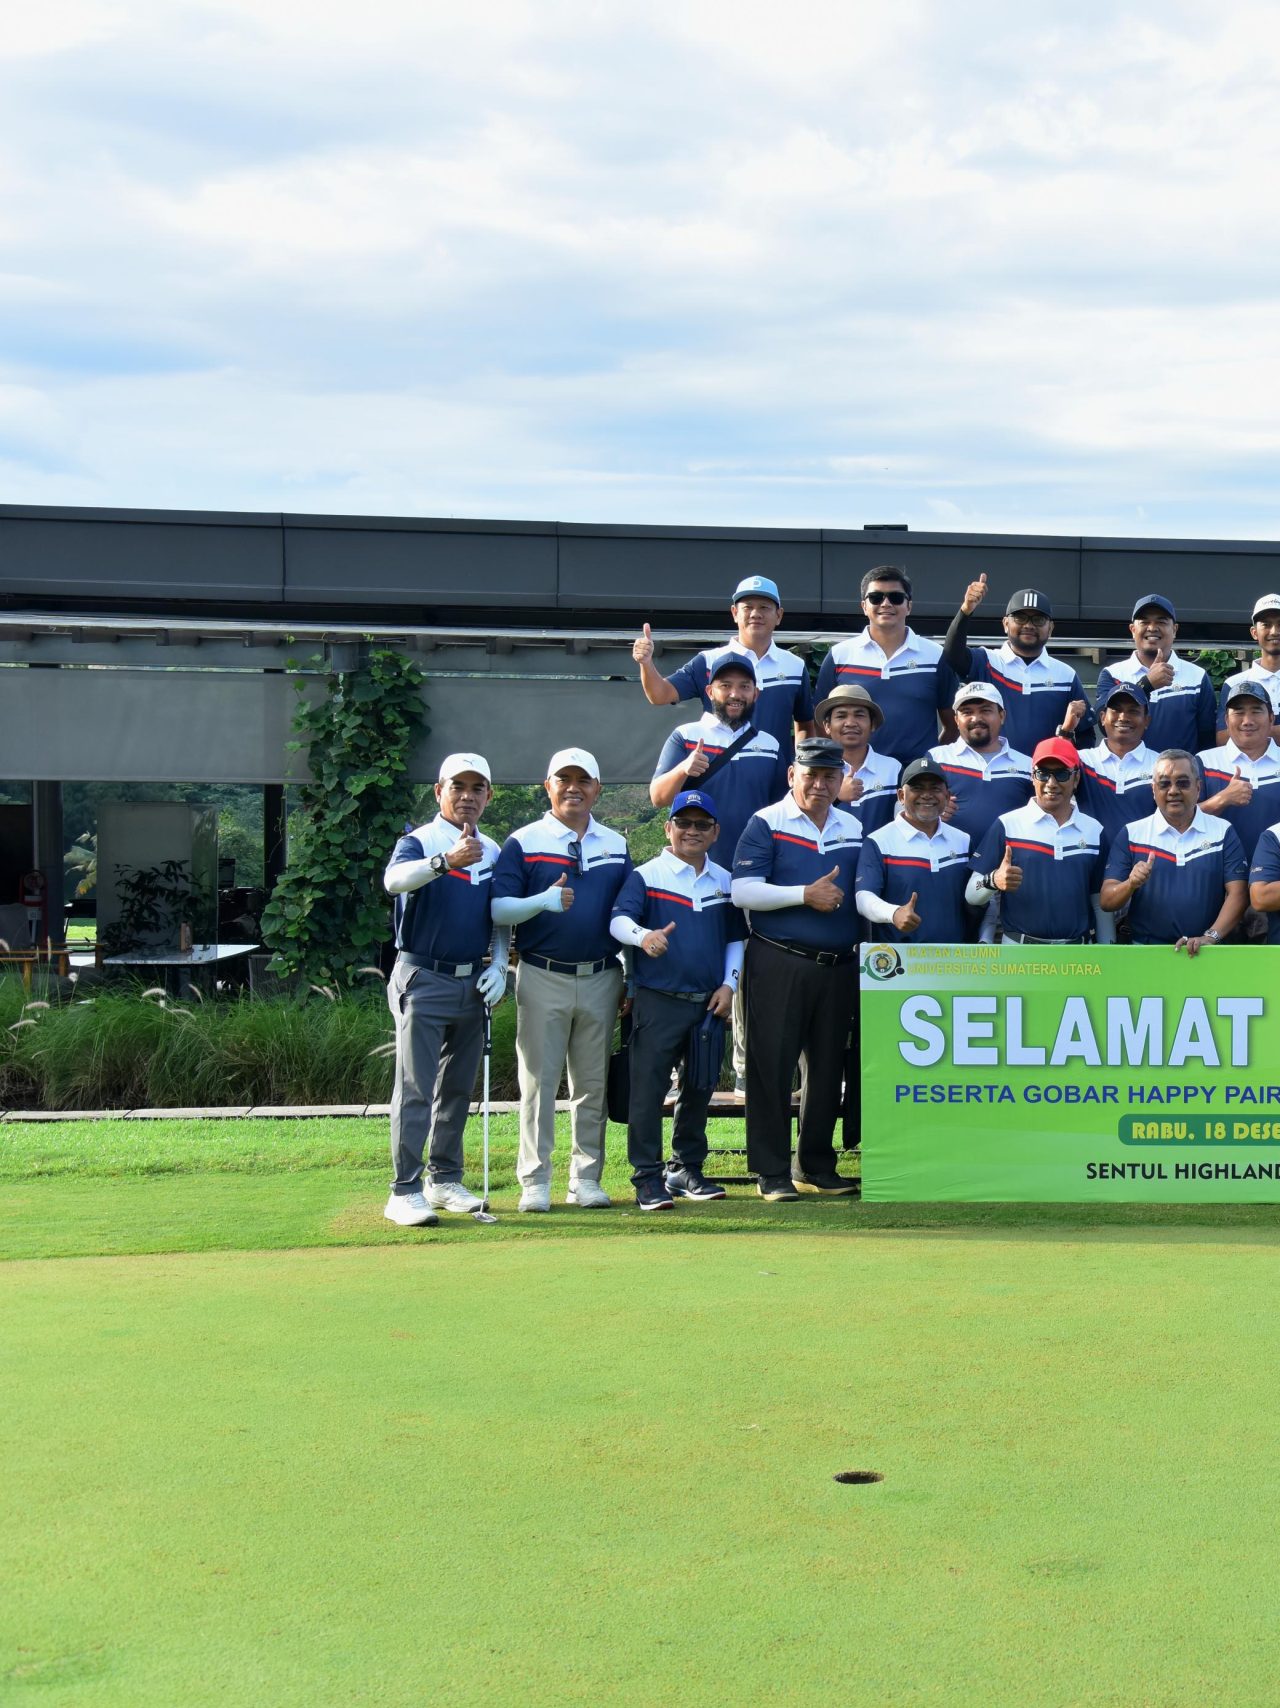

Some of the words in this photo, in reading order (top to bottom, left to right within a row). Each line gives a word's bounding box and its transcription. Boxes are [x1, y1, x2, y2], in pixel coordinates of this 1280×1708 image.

[953, 946, 1000, 958] ALUMNI
[907, 963, 987, 975] UNIVERSITAS
[991, 963, 1057, 975] SUMATERA
[1060, 963, 1101, 976] UTARA
[898, 994, 1265, 1067] SELAMAT
[896, 1085, 1016, 1104] PESERTA
[1023, 1085, 1119, 1104] GOBAR
[1129, 1085, 1216, 1104] HAPPY
[1205, 1122, 1226, 1140] 18
[1086, 1162, 1167, 1181] SENTUL
